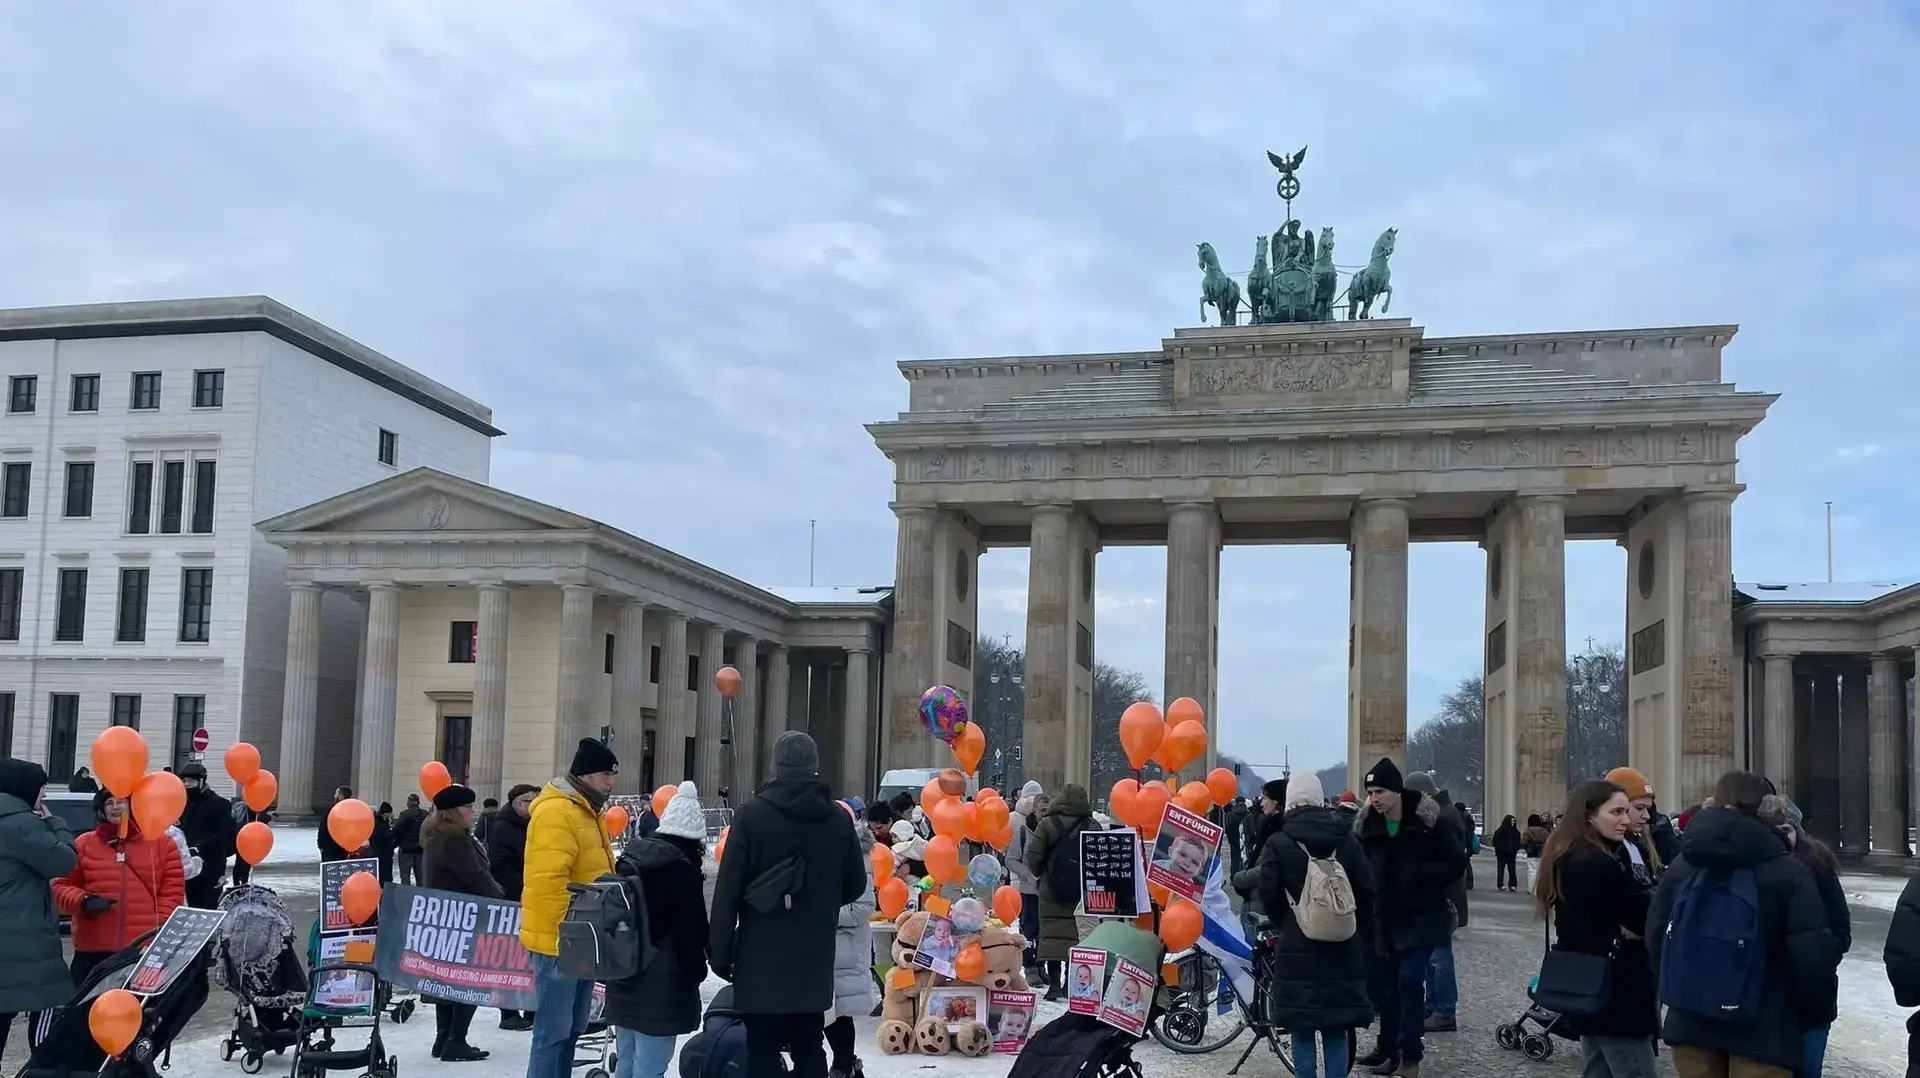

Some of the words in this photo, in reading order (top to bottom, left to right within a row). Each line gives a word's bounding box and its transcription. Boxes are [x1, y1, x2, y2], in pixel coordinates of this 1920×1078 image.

[1169, 809, 1217, 837] ENTFÜHRT
[1087, 892, 1116, 908] NOW
[409, 894, 478, 930] BRING
[487, 904, 522, 935] TH
[405, 923, 473, 964] HOME
[1073, 952, 1103, 960] ENTFÜHRT
[130, 966, 169, 985] NOW
[436, 966, 449, 977] AND
[449, 968, 480, 982] MISSING
[480, 972, 509, 984] FAMILIES
[508, 975, 531, 986] FORUM
[1123, 962, 1154, 982] ENTFÜHRT
[993, 993, 1033, 1002] ENTFÜHRT
